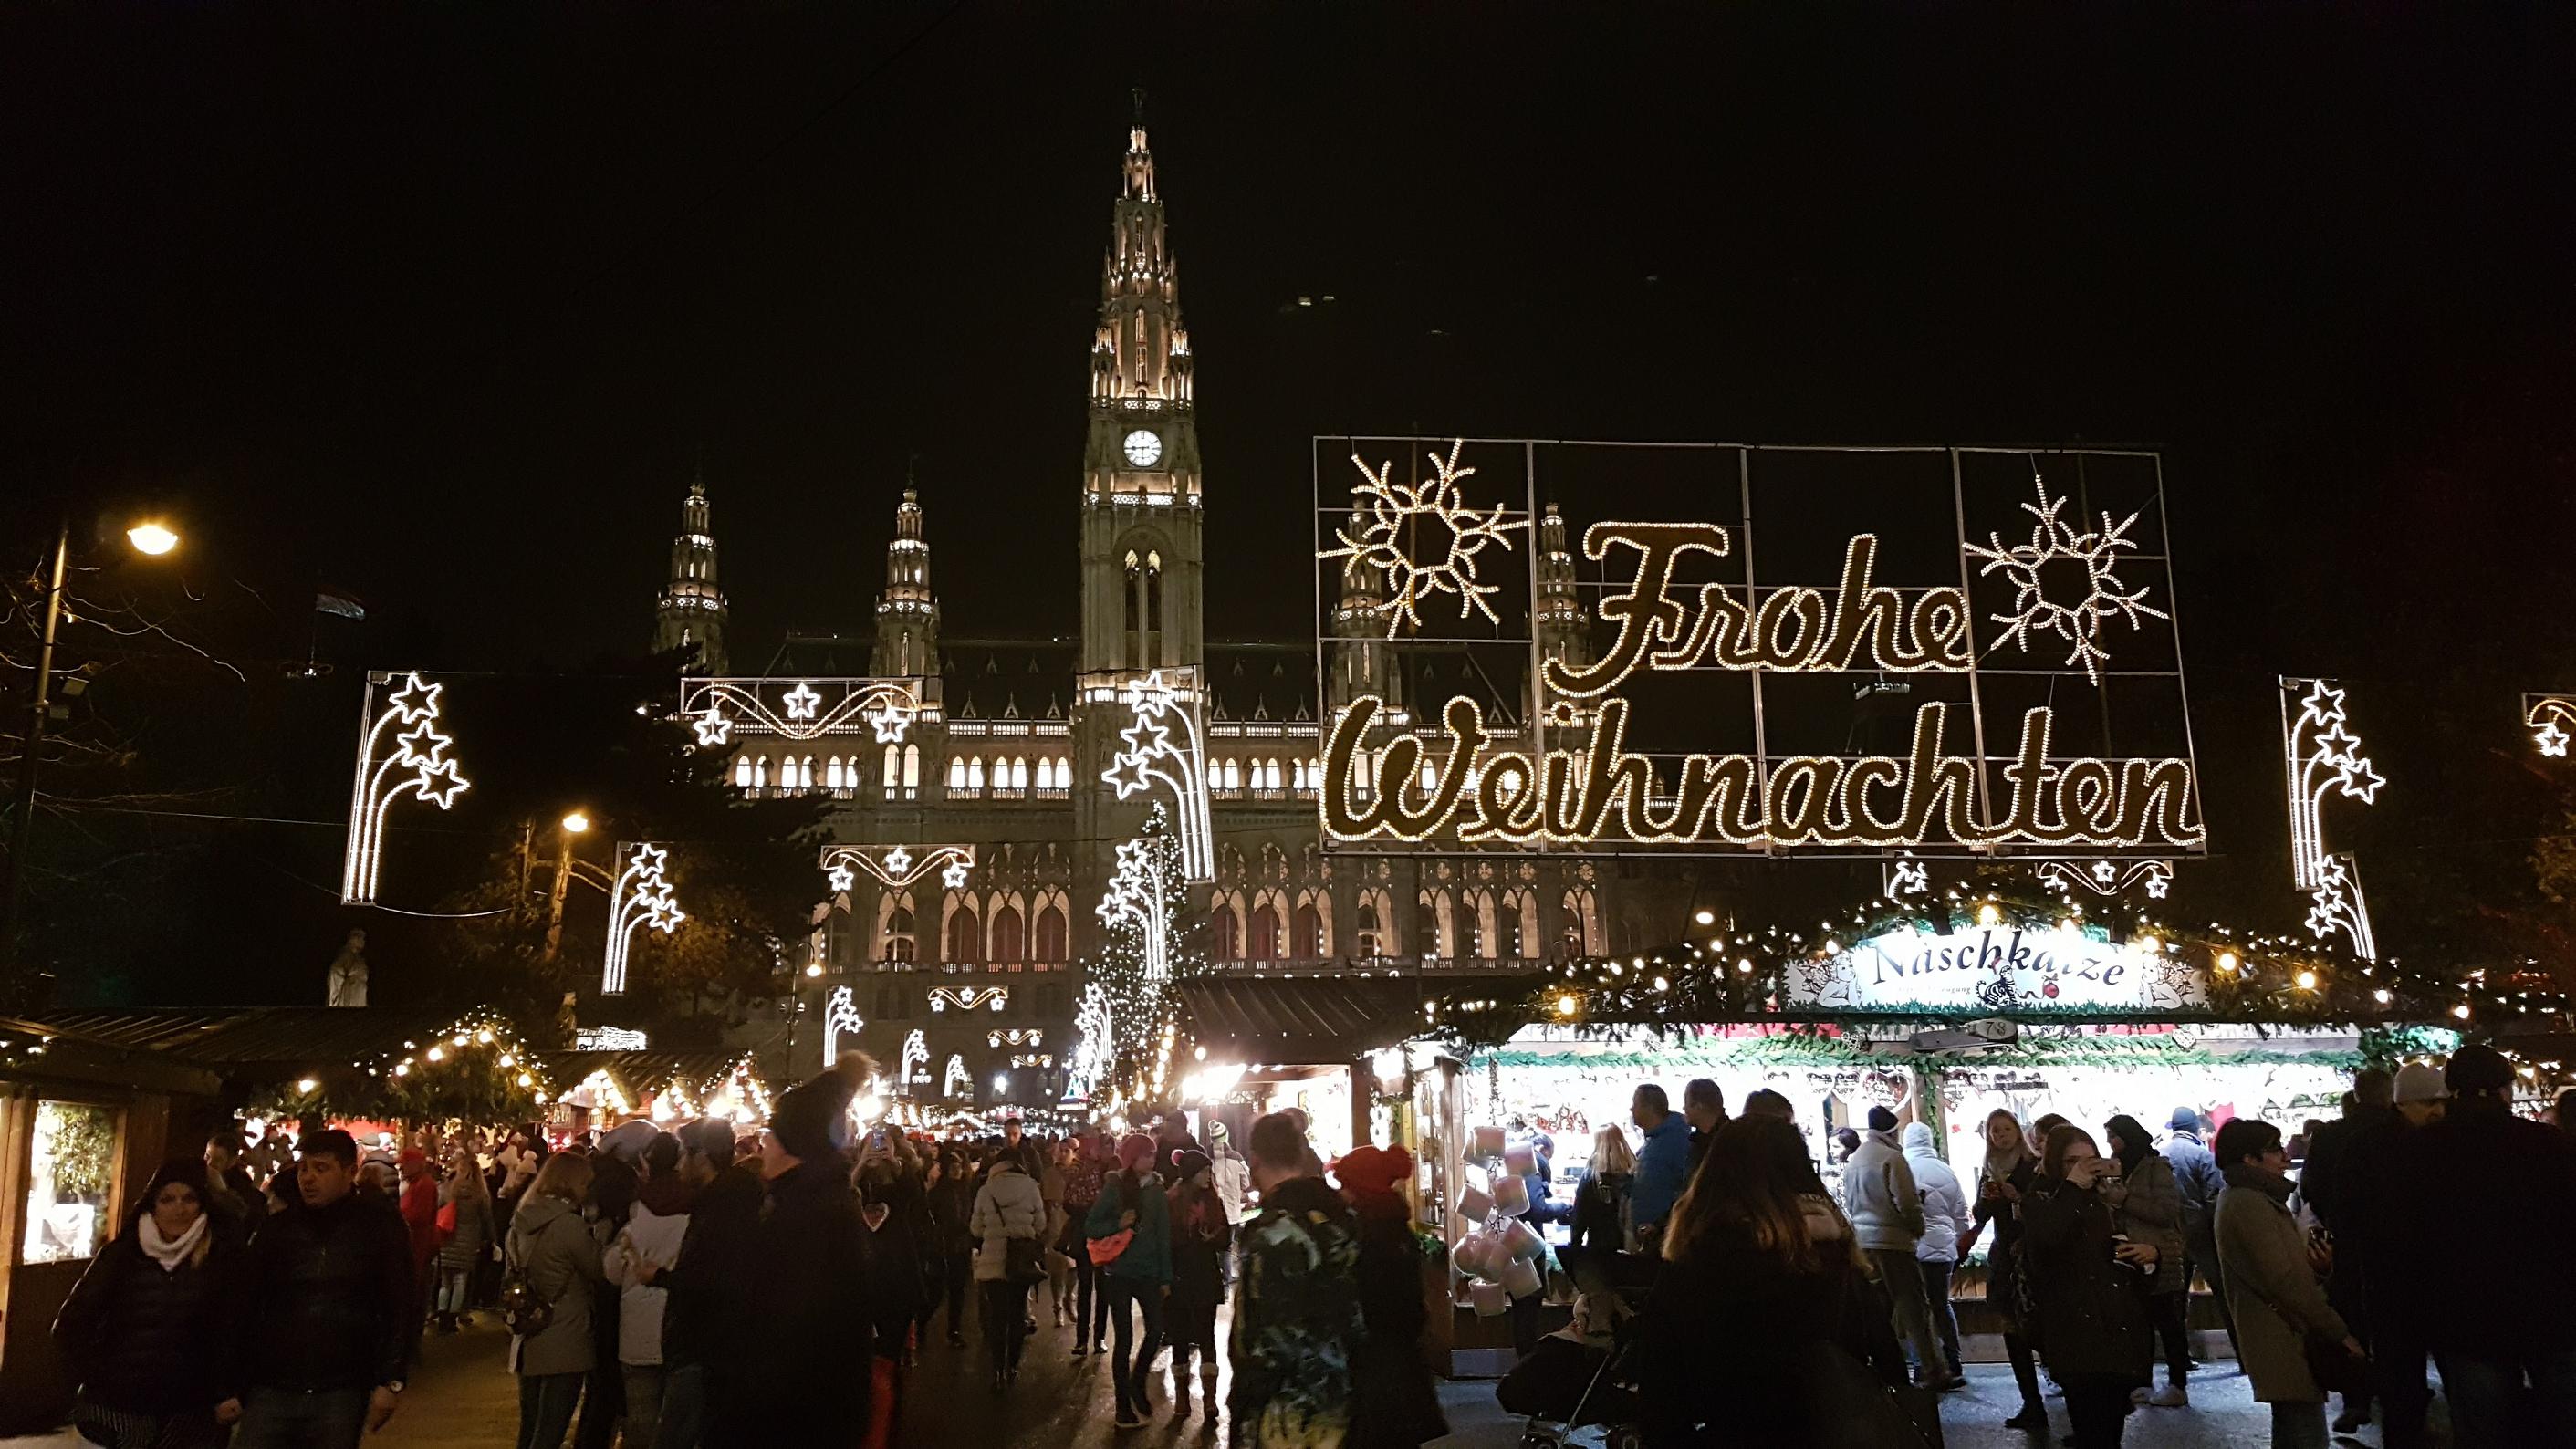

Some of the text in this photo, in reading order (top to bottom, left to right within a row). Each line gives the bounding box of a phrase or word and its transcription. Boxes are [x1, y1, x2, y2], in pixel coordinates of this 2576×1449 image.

[1542, 521, 1974, 698] Frohe
[1319, 693, 2206, 847] Weihnachten
[1985, 1021, 2007, 1037] 78
